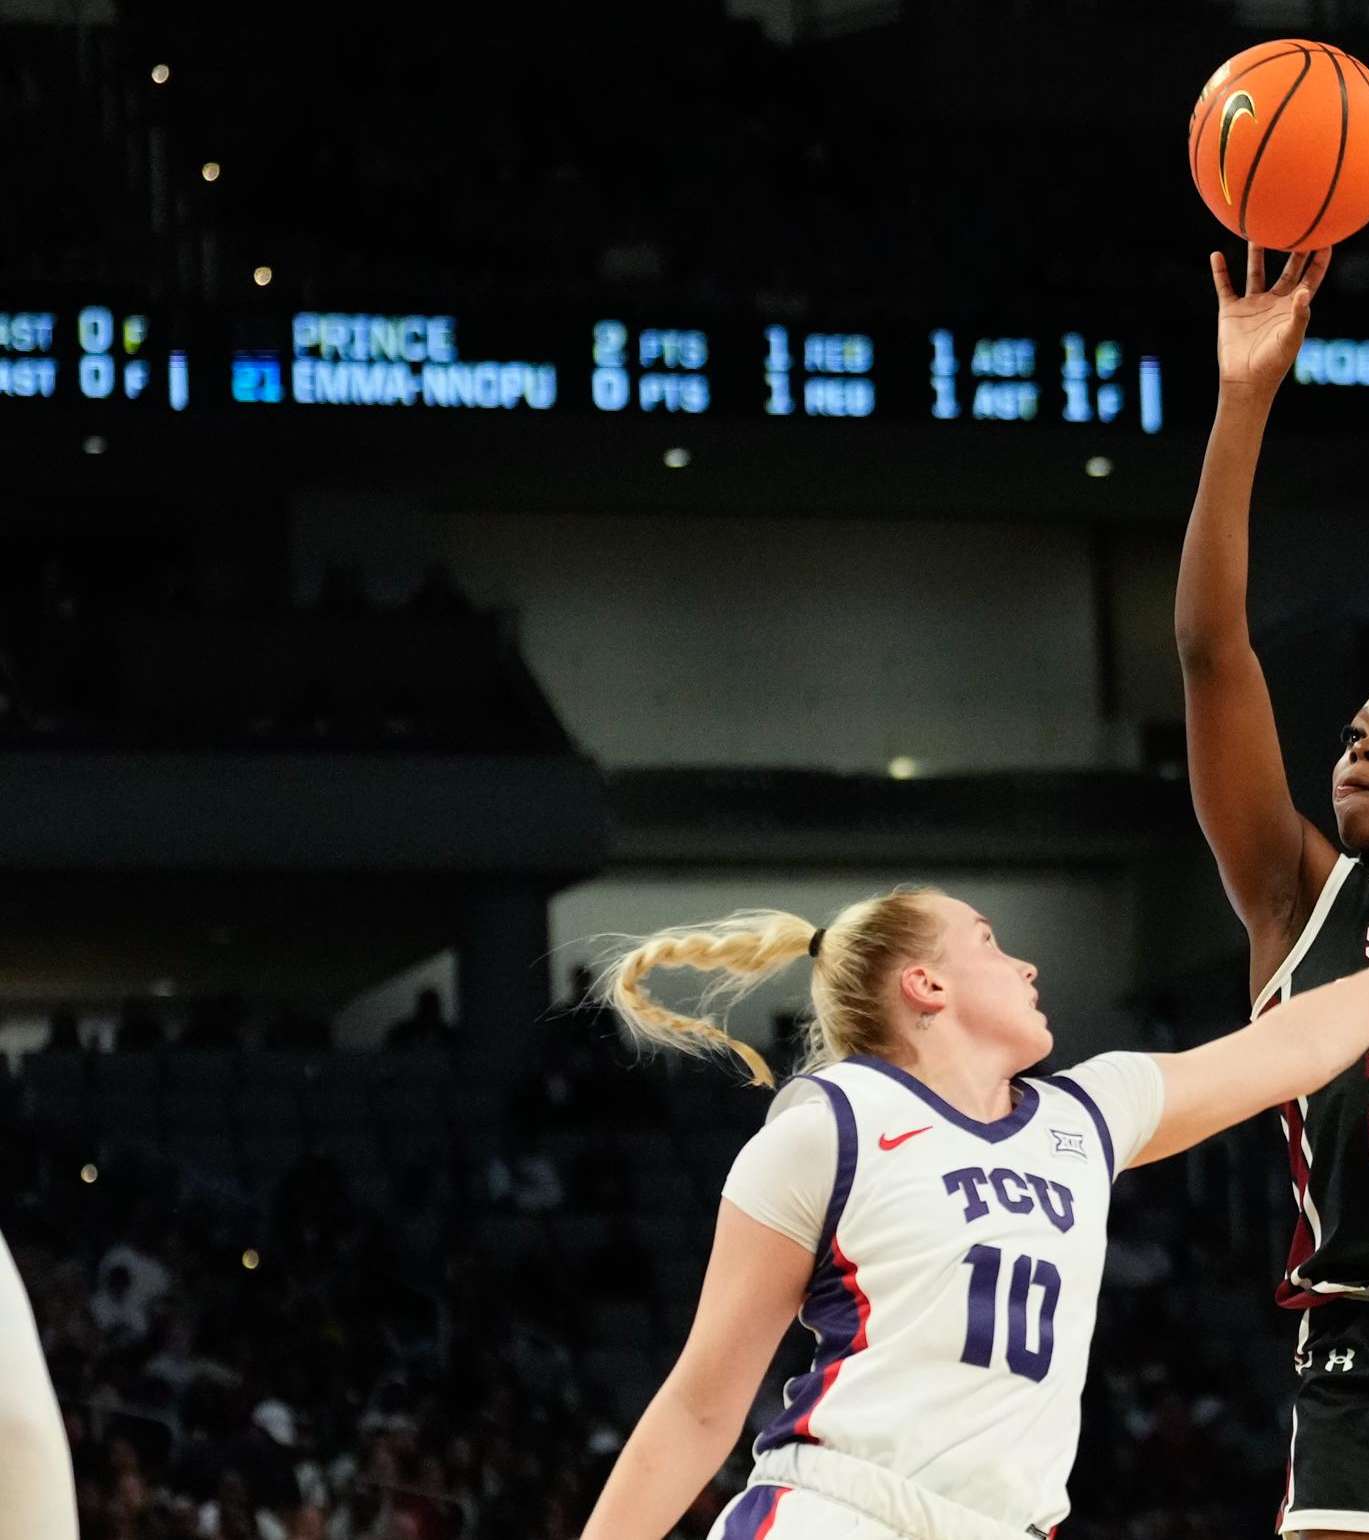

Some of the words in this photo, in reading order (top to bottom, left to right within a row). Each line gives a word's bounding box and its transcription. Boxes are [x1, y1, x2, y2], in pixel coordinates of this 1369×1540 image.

[79, 306, 114, 353] 0
[124, 316, 146, 353] F
[292, 313, 457, 362] PRINCE
[592, 321, 629, 367] 2
[639, 329, 706, 369] PTS
[765, 326, 792, 373] 1
[804, 334, 874, 374] REB
[931, 329, 960, 375] 1
[971, 339, 1035, 377] AST
[1062, 332, 1092, 380] 1
[80, 354, 115, 399] 0
[124, 361, 149, 399] F
[591, 367, 631, 411] 0
[639, 373, 709, 413] PTS
[766, 372, 793, 415] 1
[804, 377, 875, 417] REB
[931, 375, 960, 419] 1
[972, 382, 1038, 421] AST
[1063, 378, 1093, 422] 1
[942, 1166, 1074, 1233] TCU
[960, 1243, 1061, 1383] 10
